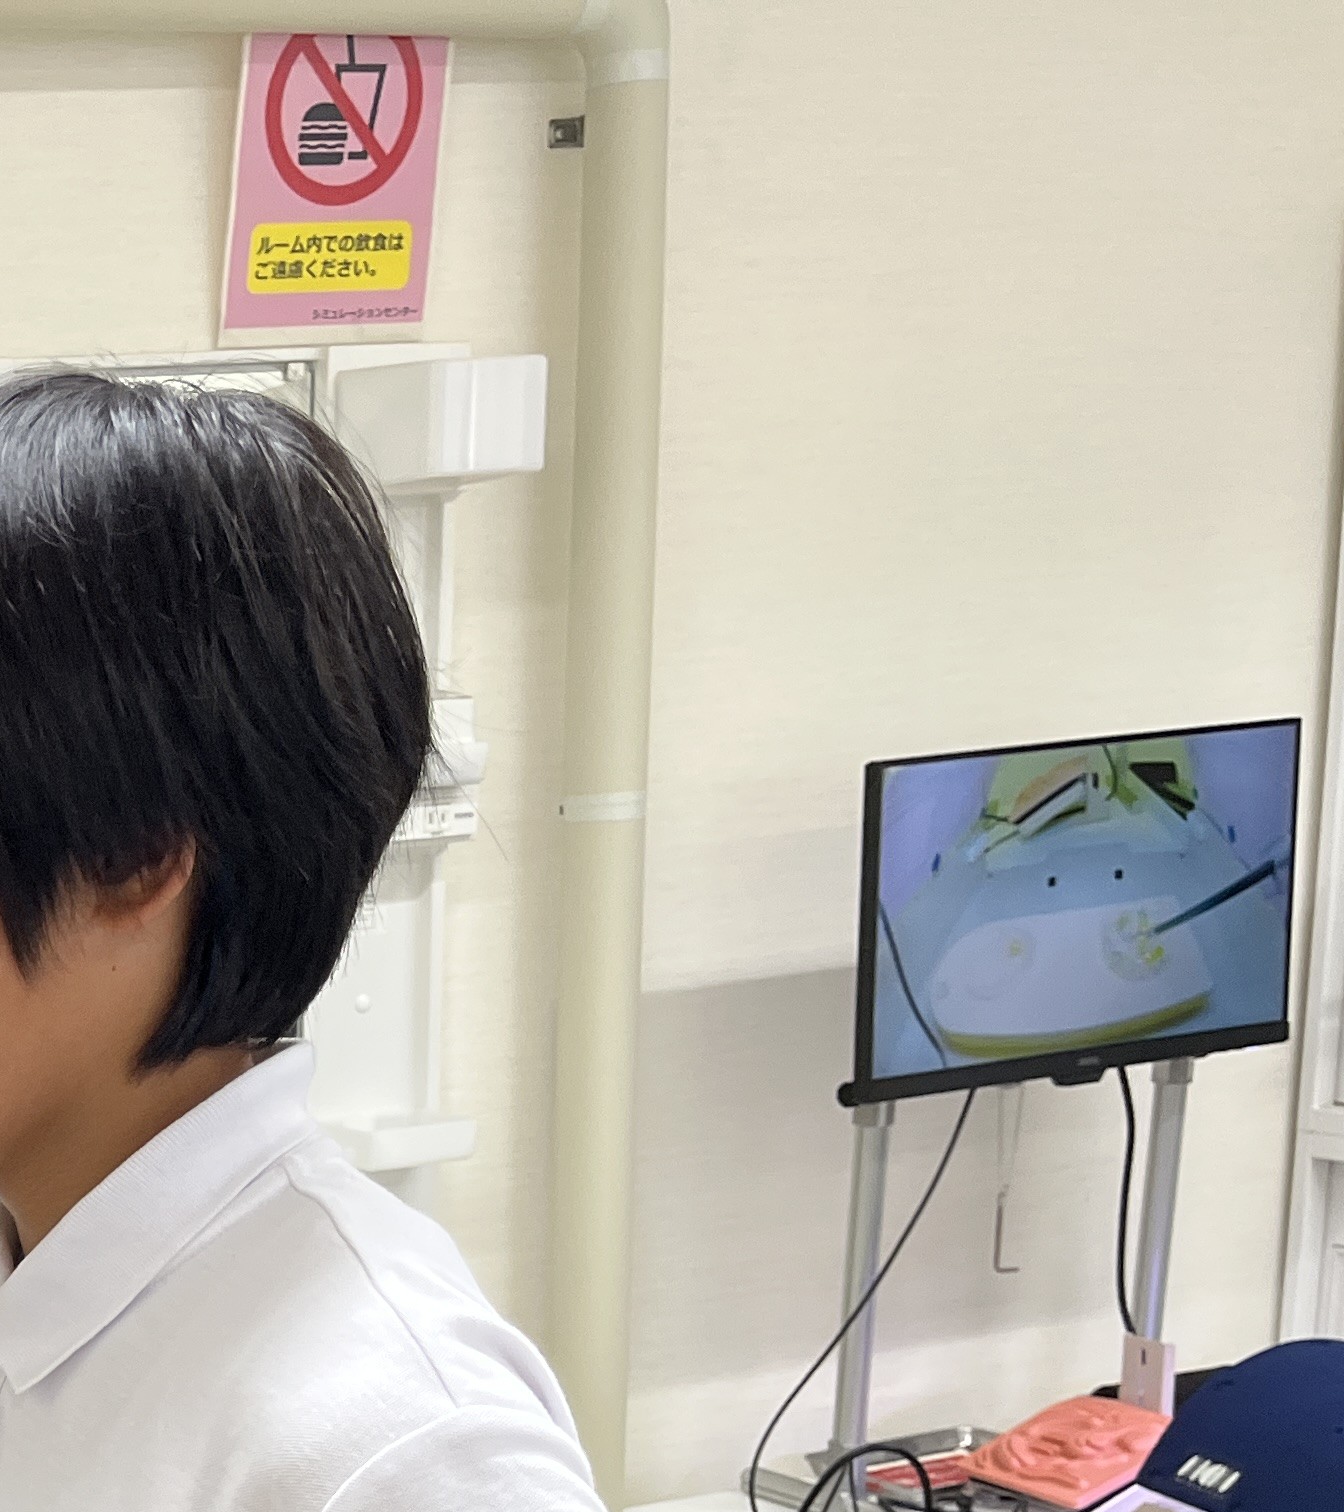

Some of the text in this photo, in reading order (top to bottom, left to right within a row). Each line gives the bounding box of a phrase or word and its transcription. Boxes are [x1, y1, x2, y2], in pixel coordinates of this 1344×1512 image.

[257, 234, 404, 254] ルーム内での飲食は
